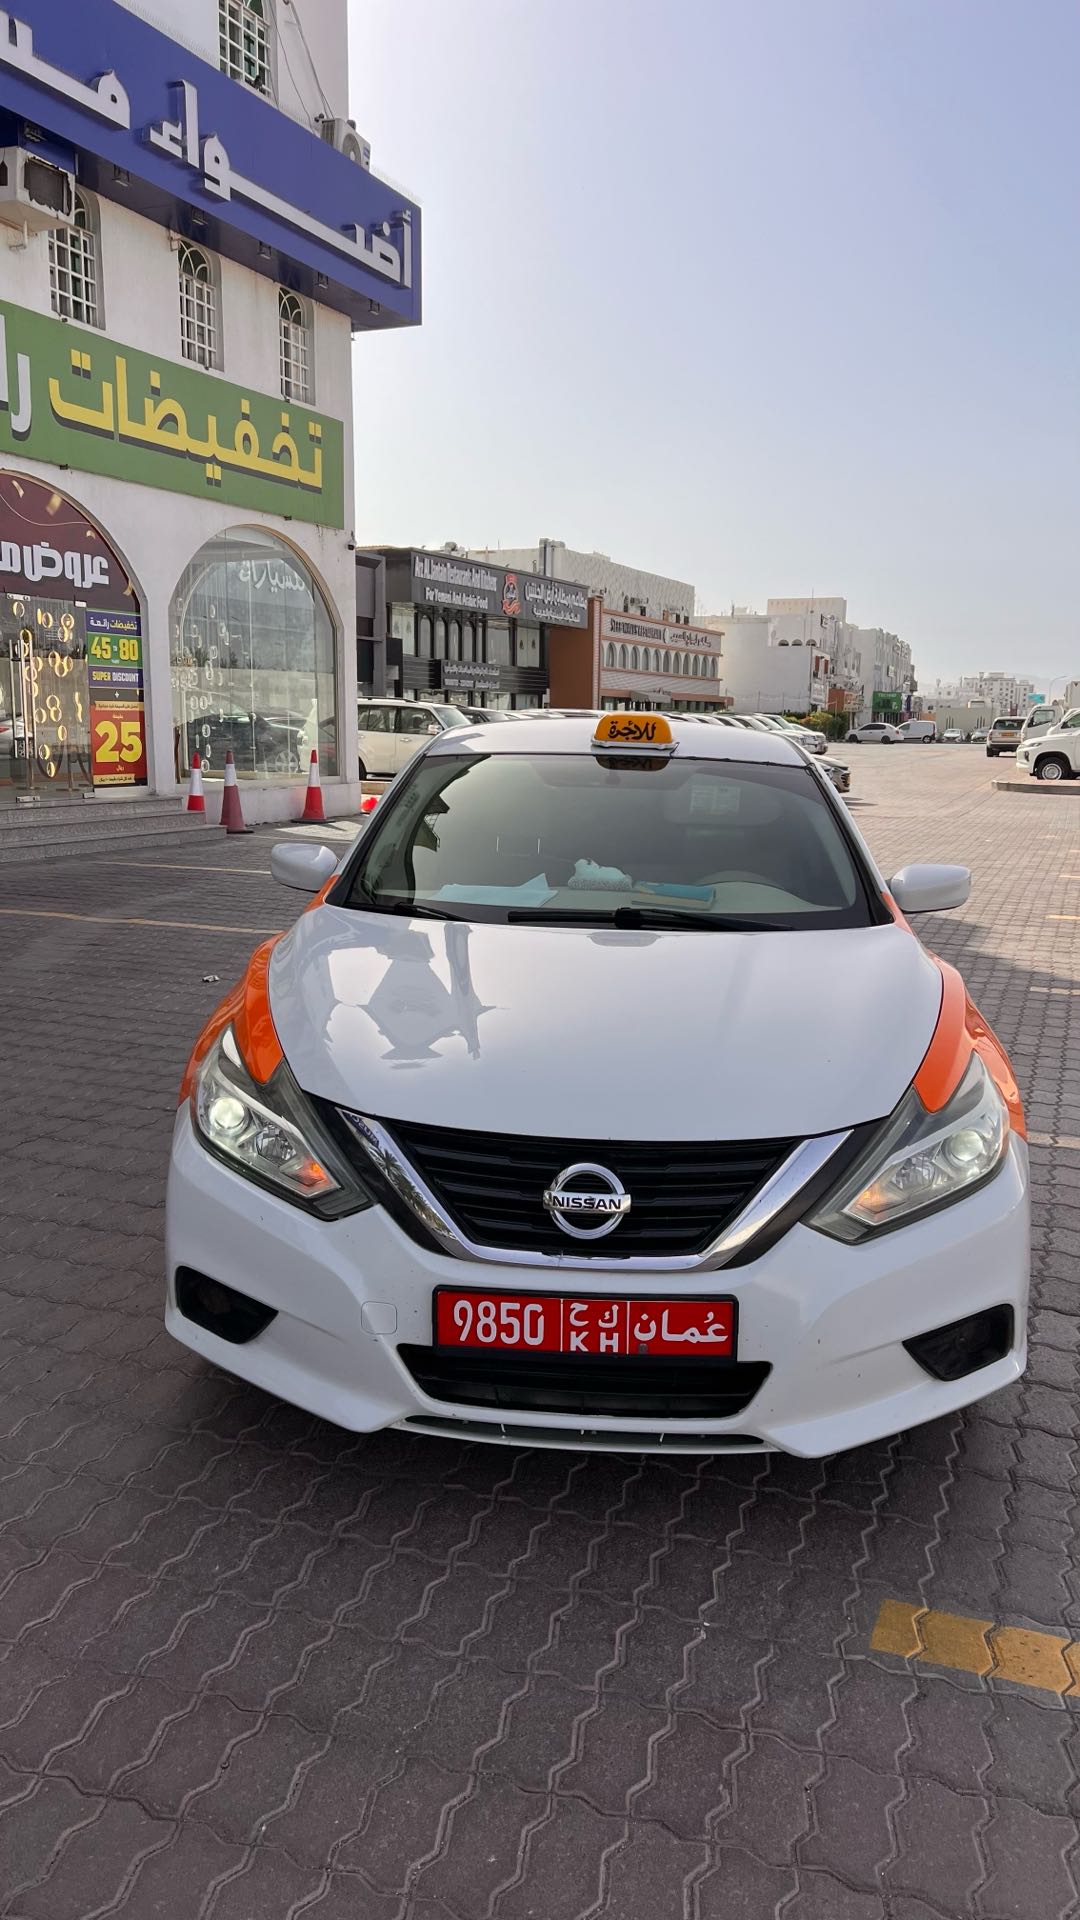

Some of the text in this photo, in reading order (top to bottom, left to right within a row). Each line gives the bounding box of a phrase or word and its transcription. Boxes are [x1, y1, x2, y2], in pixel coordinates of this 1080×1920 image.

[147, 79, 412, 289] أضواء
[49, 349, 322, 489] تخفيضات
[23, 541, 109, 588] عروض
[110, 619, 138, 631] تخفيضات
[91, 636, 139, 661] 45 80
[92, 671, 139, 683] SUPER DISCOUNT
[95, 720, 143, 763] 25
[552, 1195, 622, 1211] NISSAN
[453, 1299, 545, 1346] 9850
